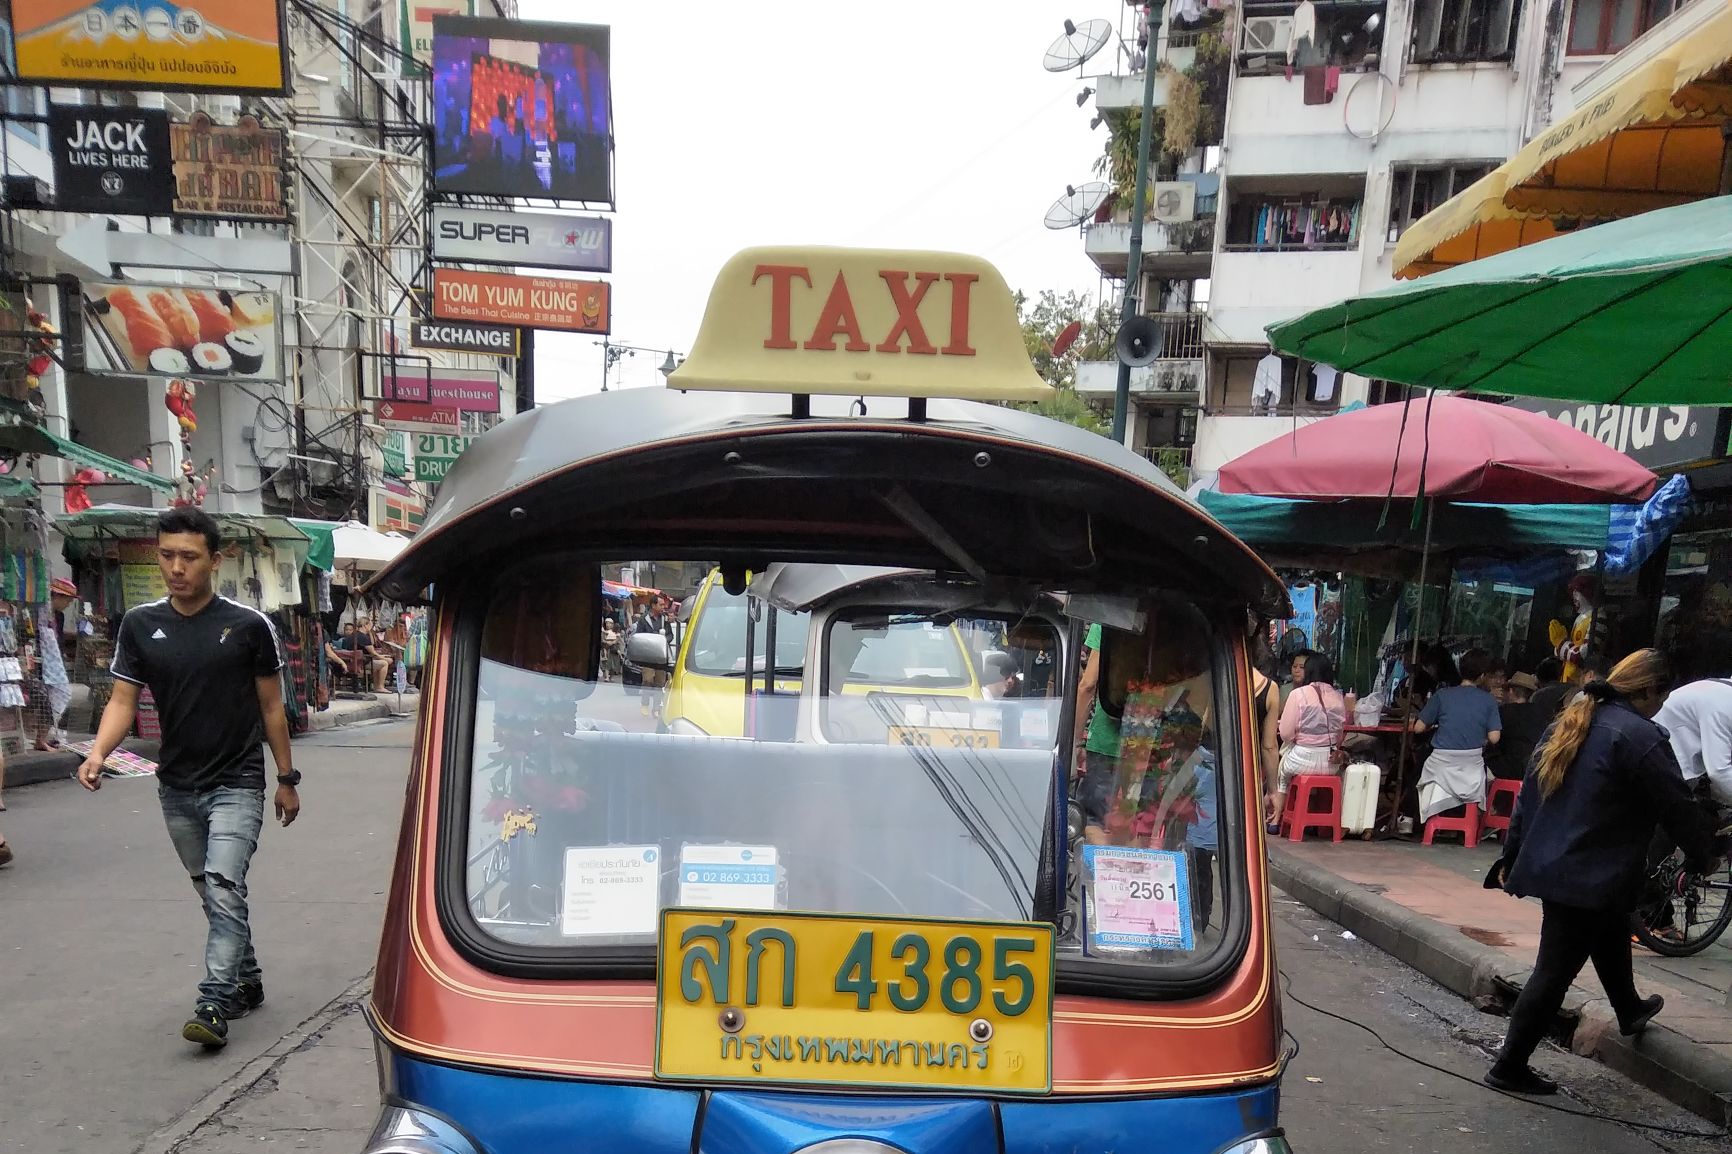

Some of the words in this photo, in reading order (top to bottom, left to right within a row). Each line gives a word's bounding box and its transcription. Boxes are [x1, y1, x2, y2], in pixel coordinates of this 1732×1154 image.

[66, 119, 147, 152] JACK
[68, 150, 108, 167] LIVES
[111, 152, 150, 169] HERE
[176, 199, 199, 210] BAR
[216, 201, 284, 215] RESTAURANT
[439, 220, 530, 245] SUPER
[439, 281, 478, 304] TOM
[485, 285, 524, 308] YUM
[530, 289, 578, 312] KUNG
[444, 304, 459, 314] The
[460, 305, 479, 315] Best
[481, 307, 499, 317] Thai
[500, 309, 530, 320] Cuisine
[751, 264, 979, 356] TAXI
[420, 325, 511, 347] EXCHANGE
[430, 411, 456, 424] ATM
[702, 872, 717, 882] 02
[719, 872, 740, 882] 869
[743, 872, 770, 883] 3333
[1129, 880, 1177, 902] 2561
[680, 920, 797, 1008] สก
[834, 929, 1035, 1018] 4385
[720, 1032, 990, 1072] กรุงเทพมหานคร
